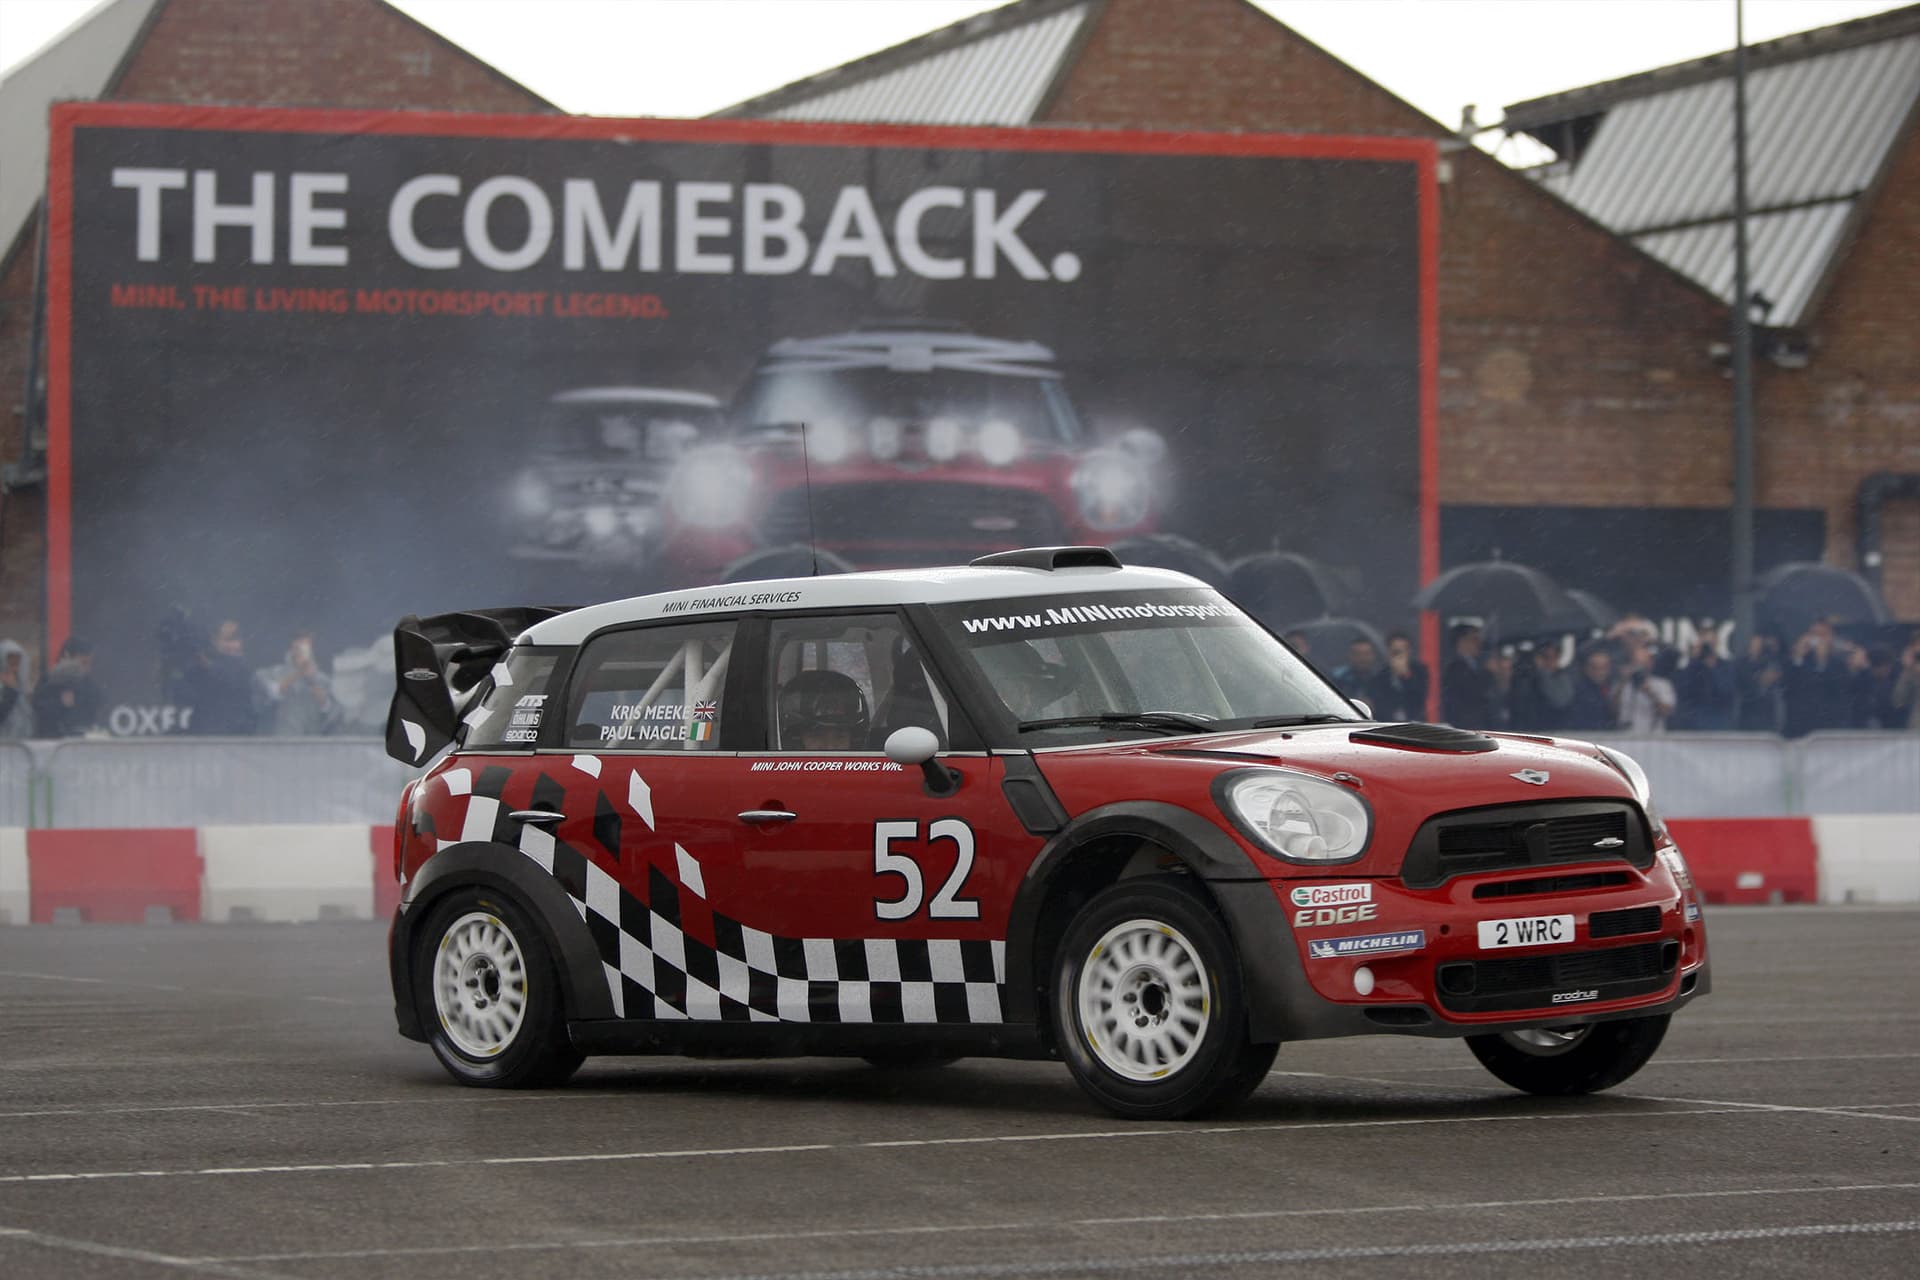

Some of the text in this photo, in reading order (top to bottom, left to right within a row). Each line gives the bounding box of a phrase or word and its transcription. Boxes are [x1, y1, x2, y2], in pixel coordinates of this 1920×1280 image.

[112, 168, 1082, 282] THE COMEBACK.
[111, 284, 671, 319] MINI. THE LIVING MOTORSPORT LEGEND.
[662, 591, 802, 613] MINI FINANCIAL SERVICES
[610, 704, 691, 720] KRIS MEEKE
[600, 724, 688, 741] PAUL NAGLE
[750, 761, 775, 771] MINI
[773, 761, 803, 771] JOHN
[803, 761, 843, 771] COOPER
[844, 761, 881, 771] WORKS
[873, 816, 981, 921] 52
[1312, 886, 1367, 904] Castrol
[1293, 903, 1379, 928] EDGE
[1338, 934, 1420, 951] MICHELIN
[1495, 918, 1563, 945] 2 WRC
